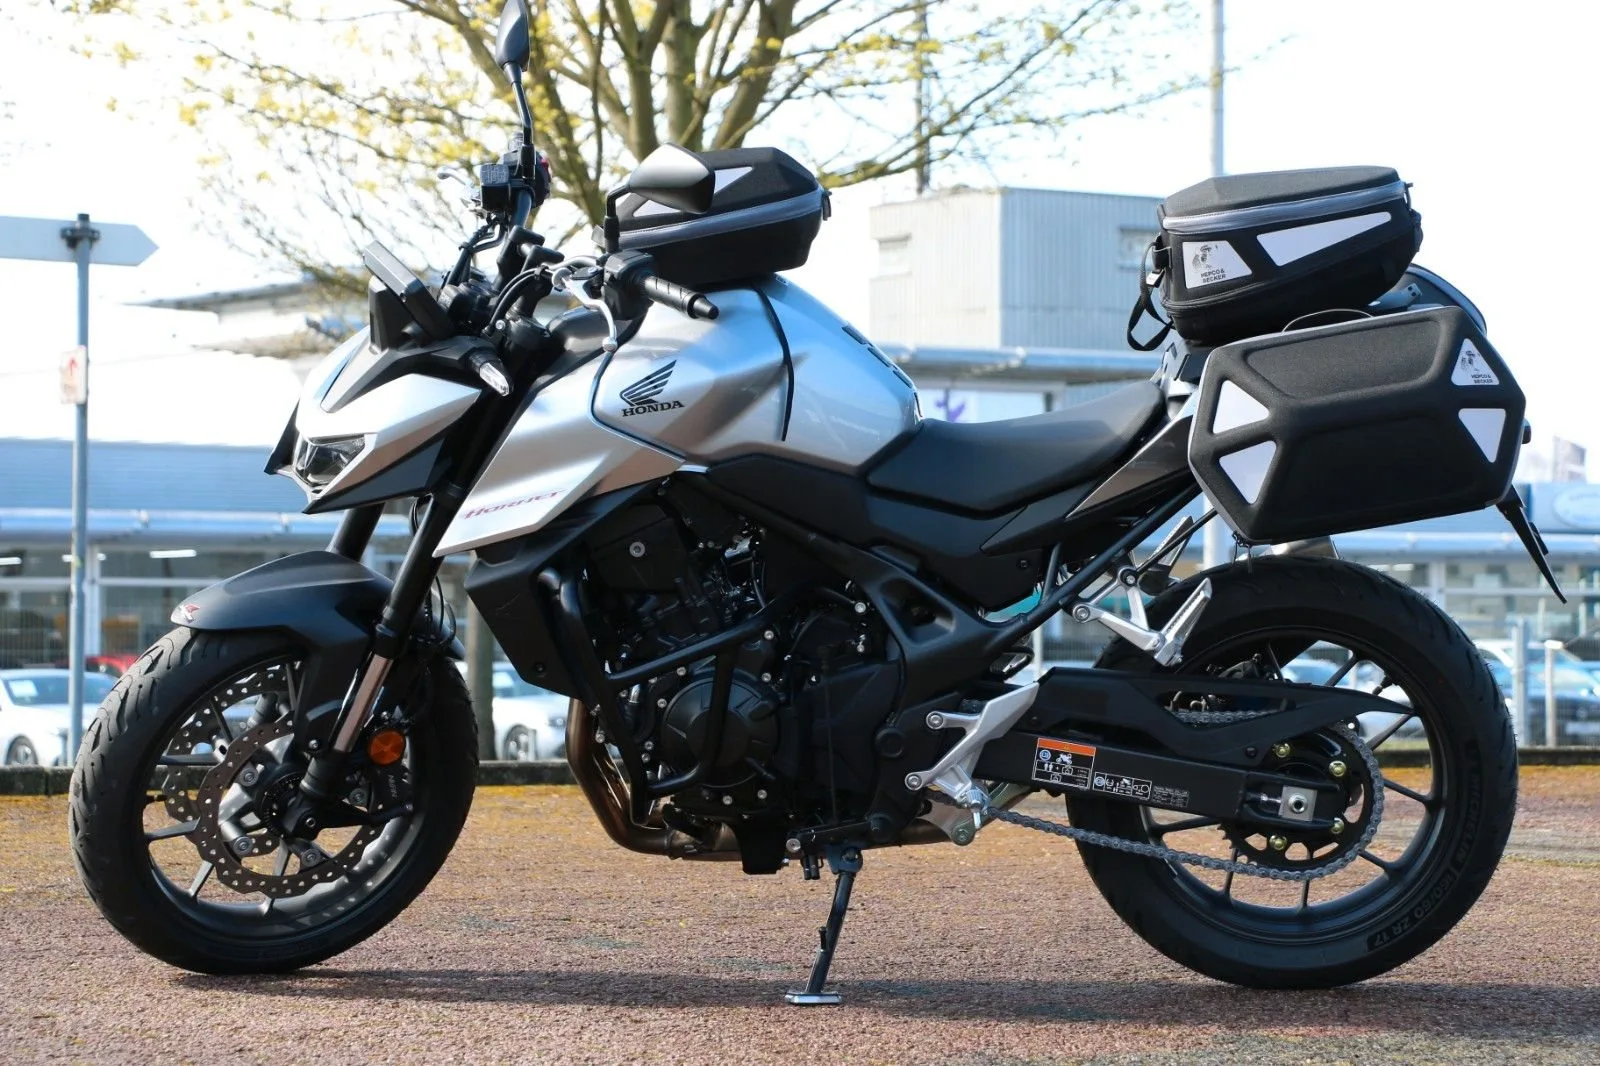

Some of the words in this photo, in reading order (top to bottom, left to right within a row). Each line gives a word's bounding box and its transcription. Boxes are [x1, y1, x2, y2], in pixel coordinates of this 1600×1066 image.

[1202, 274, 1226, 283] BECKER
[621, 400, 685, 417] HONDA
[1373, 931, 1390, 947] 17
